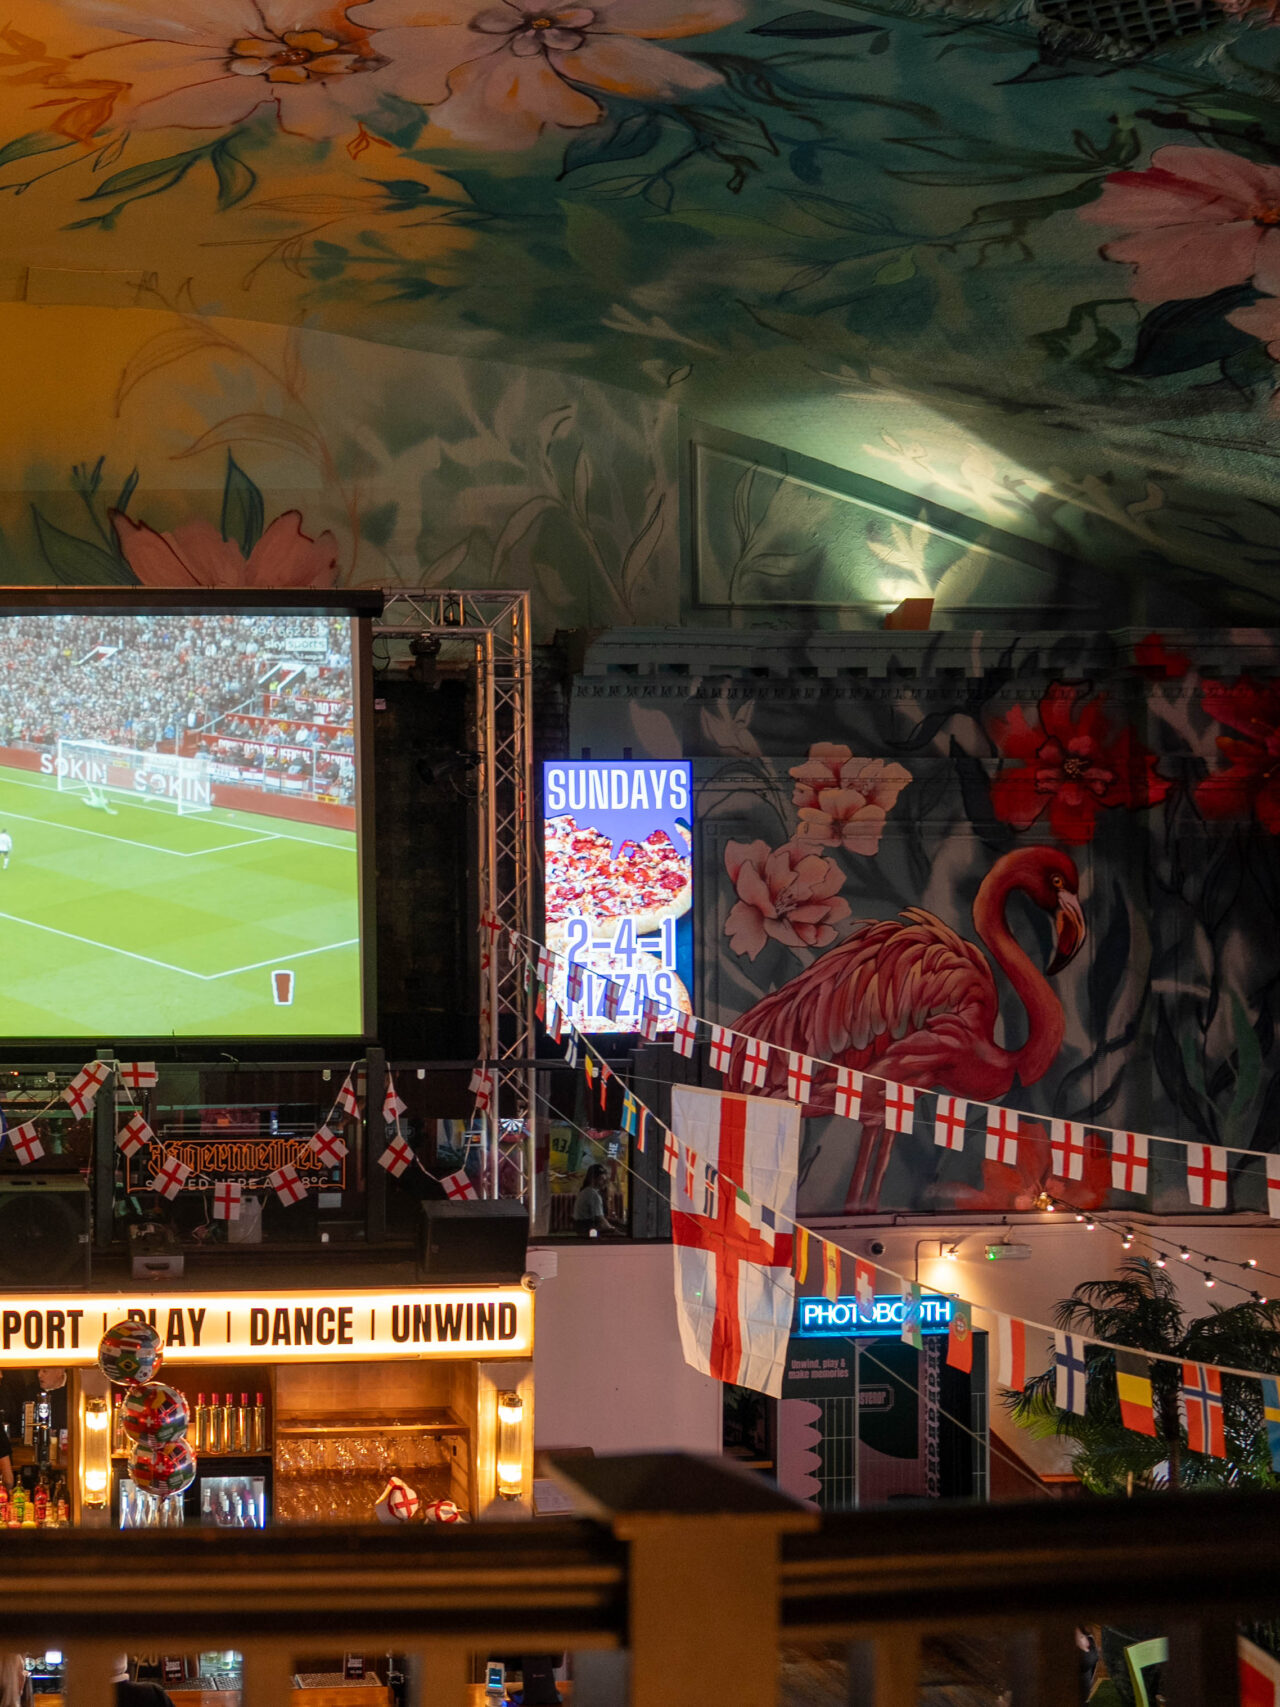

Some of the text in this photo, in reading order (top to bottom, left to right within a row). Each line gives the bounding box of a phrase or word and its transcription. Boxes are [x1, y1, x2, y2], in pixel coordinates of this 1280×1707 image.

[40, 753, 108, 785] SOKIN
[134, 769, 211, 804] SOKIN
[548, 769, 687, 810] SUNDAYS
[567, 917, 677, 970] 2-4-1
[250, 1307, 354, 1346] DANCE
[391, 1302, 517, 1343] UNWIND
[804, 1301, 951, 1325] PHOTOBOTH
